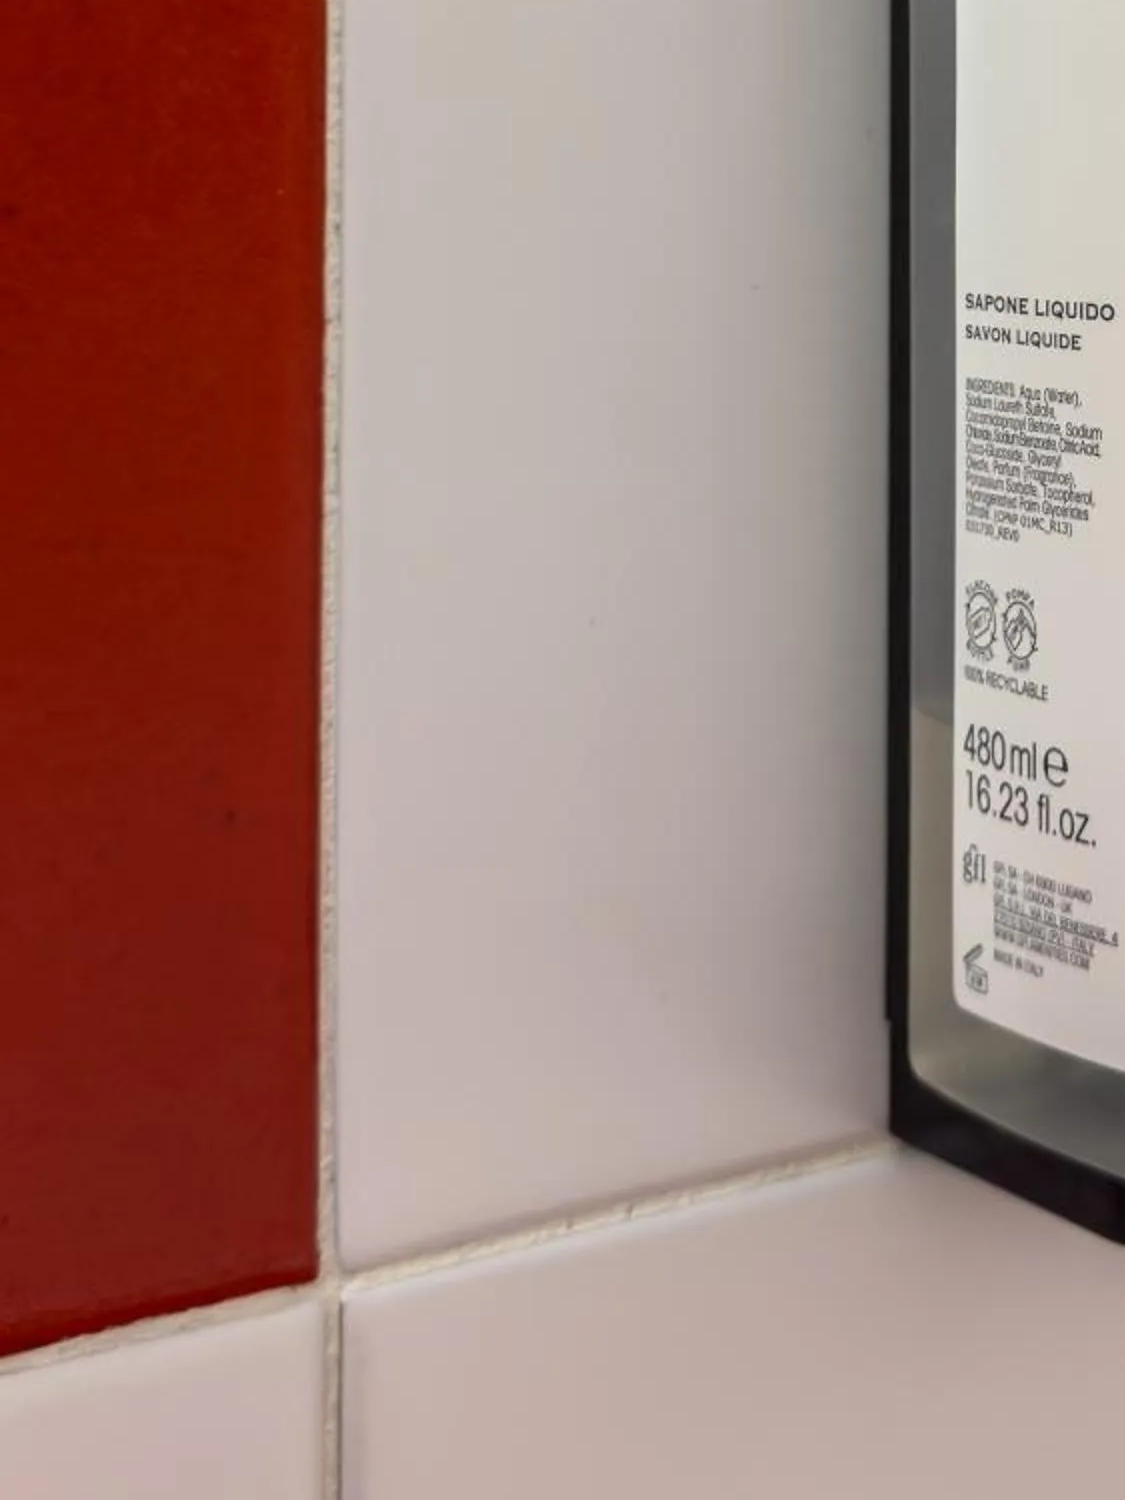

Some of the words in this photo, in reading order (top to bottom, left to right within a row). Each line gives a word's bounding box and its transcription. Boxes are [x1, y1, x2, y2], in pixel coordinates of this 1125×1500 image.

[965, 292, 1029, 315] SAPONE
[1034, 299, 1115, 322] LIQUIDO
[965, 323, 1011, 345] SAVON
[1016, 329, 1082, 351] LIQUIDE
[1065, 421, 1102, 441] Sodium
[965, 769, 1029, 827] 16.23
[1037, 792, 1097, 848] fl.oz.
